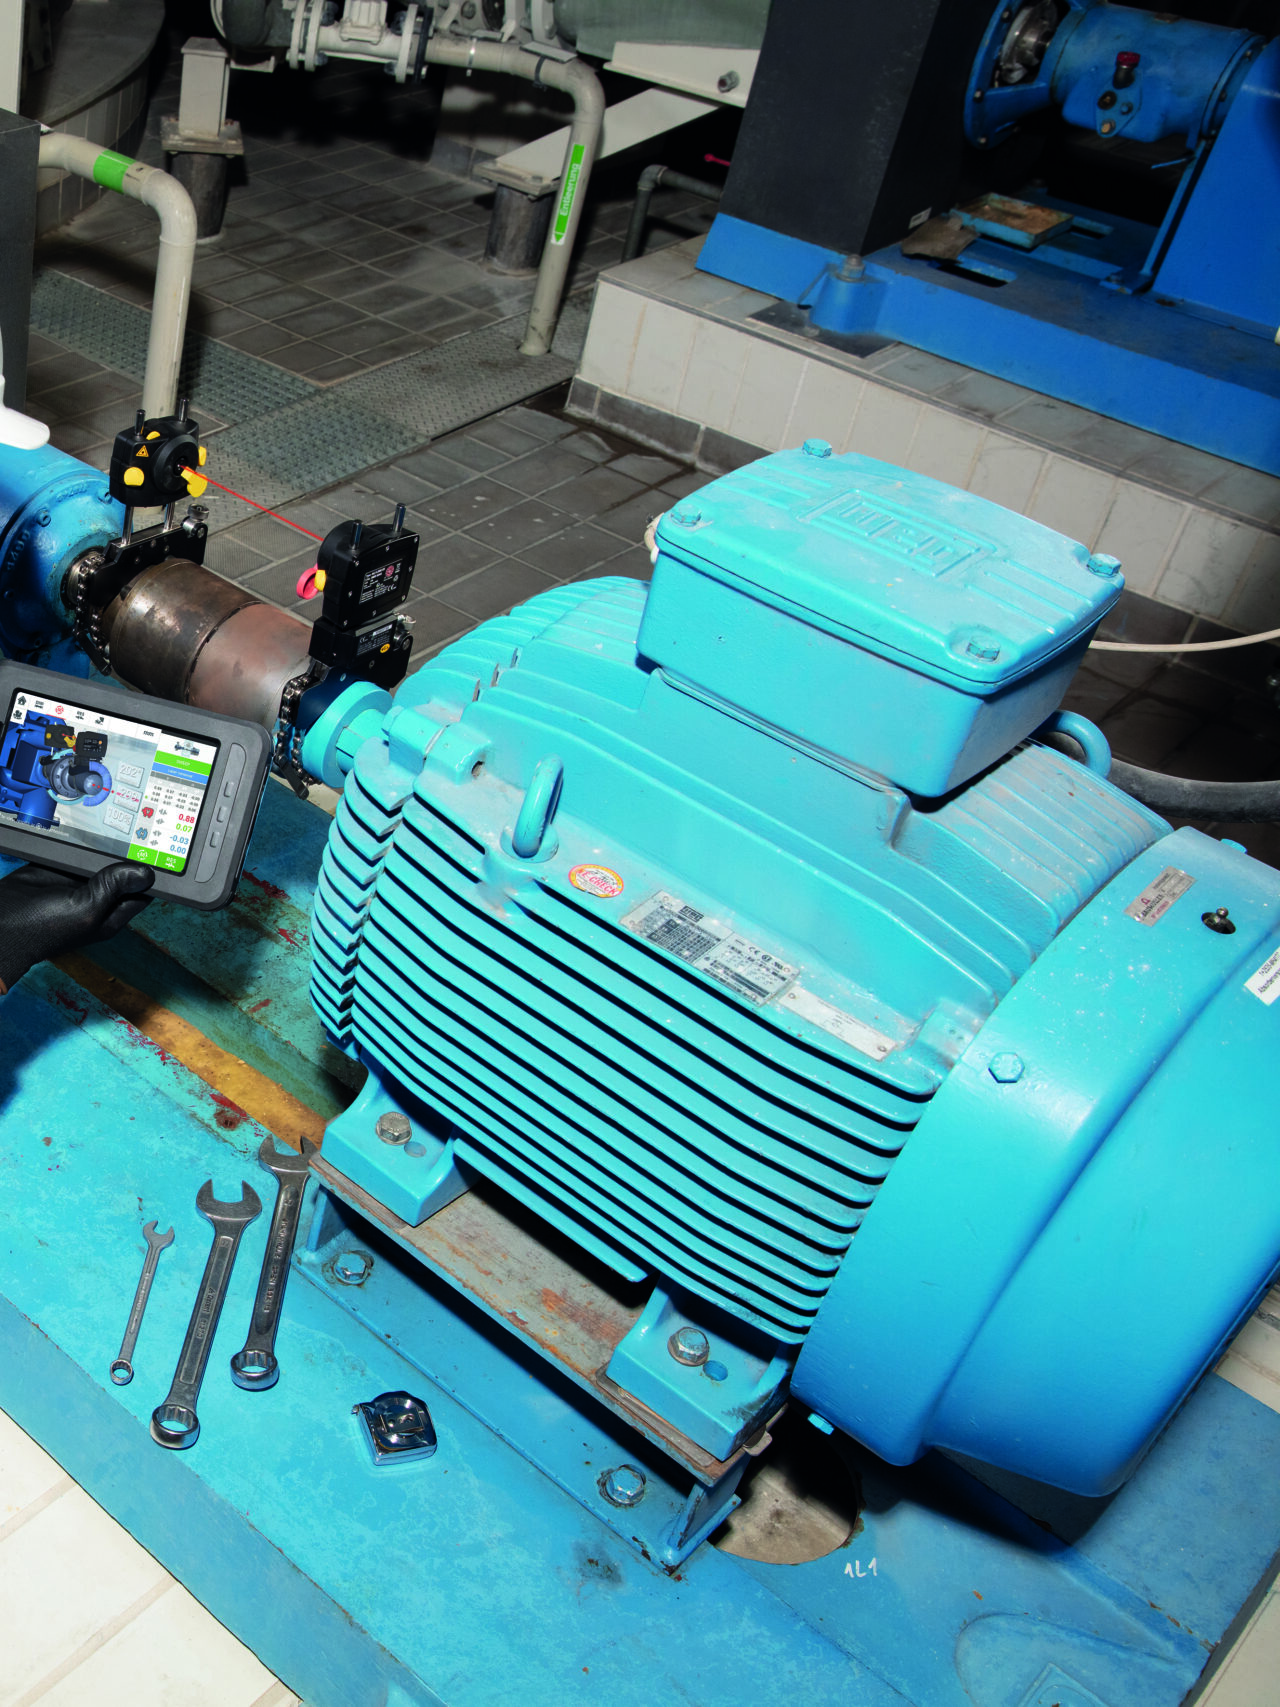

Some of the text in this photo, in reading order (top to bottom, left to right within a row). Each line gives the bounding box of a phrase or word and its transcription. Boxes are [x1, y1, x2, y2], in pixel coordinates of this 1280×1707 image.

[560, 163, 580, 216] Entleerung
[178, 813, 195, 824] 0.88
[175, 823, 193, 833] 0.07
[169, 834, 189, 845] -0.03
[169, 844, 187, 855] 0.00
